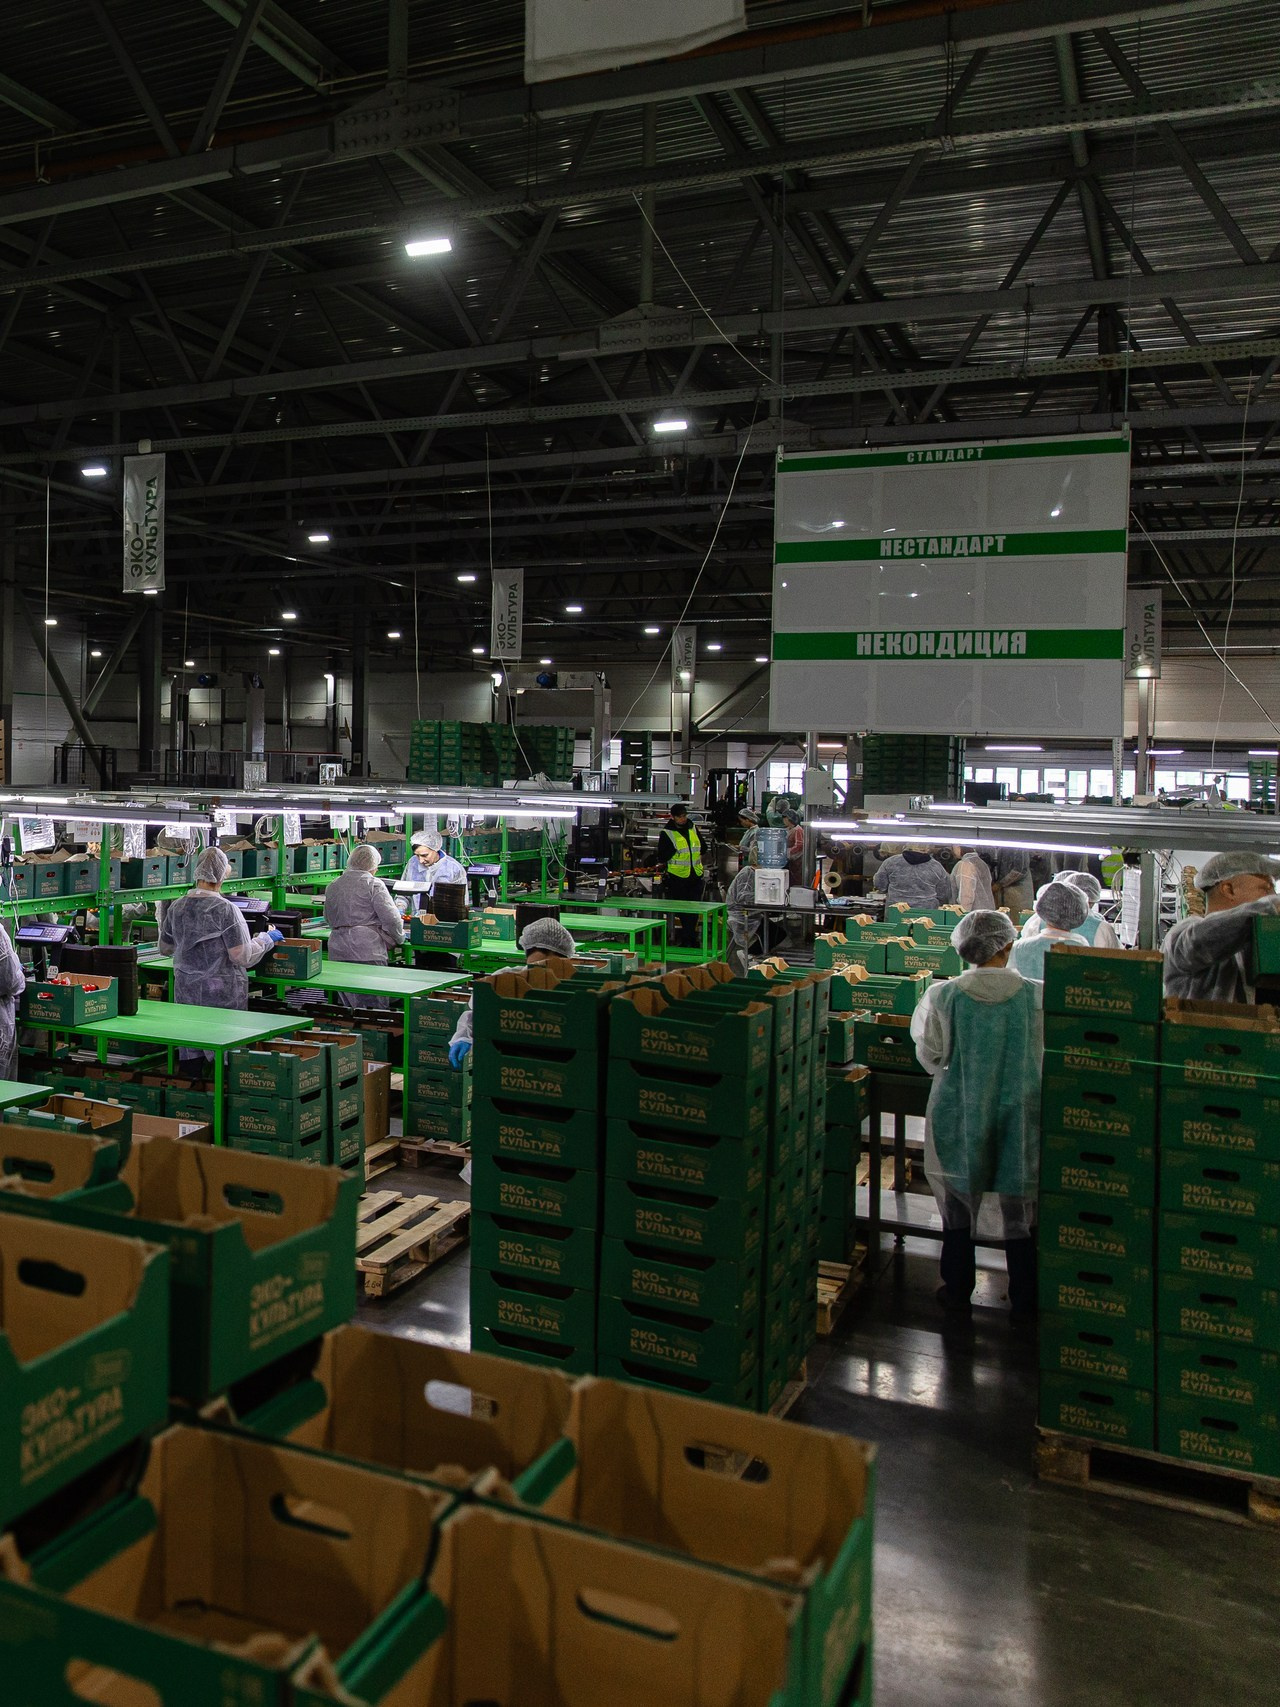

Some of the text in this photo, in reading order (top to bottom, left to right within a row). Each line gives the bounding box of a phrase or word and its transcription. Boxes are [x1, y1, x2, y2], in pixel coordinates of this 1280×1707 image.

[907, 447, 985, 463] СТАНДАРТ
[145, 476, 158, 576] КУЛЬТУРА
[130, 522, 144, 578] ЭКО-
[879, 535, 1007, 557] НЕСТАНДАРТ
[507, 582, 518, 649] КУЛЬТУРА
[496, 613, 506, 650] ЭКО-
[856, 631, 1027, 658] НЕКОНДИЦИЯ
[1065, 986, 1102, 996] ЭКО-
[852, 997, 893, 1006] КУЛЬТУРА
[1065, 995, 1133, 1010] КУЛЬТУРА
[499, 1009, 534, 1020] ЭКО-
[499, 1018, 562, 1035] КУЛЬТУРА
[641, 1028, 678, 1041] ЭКО-
[640, 1038, 709, 1057] КУЛЬТУРА
[239, 1072, 260, 1080] ЭКО-
[500, 1066, 534, 1078] ЭКО-
[239, 1078, 277, 1089] КУЛЬТУРА
[500, 1075, 562, 1094] КУЛЬТУРА
[639, 1089, 676, 1101] ЭКО-
[639, 1099, 706, 1119] КУЛЬТУРА
[1063, 1106, 1100, 1117] ЭКО-
[239, 1115, 260, 1123] ЭКО-
[1063, 1115, 1131, 1133] КУЛЬТУРА
[1183, 1120, 1223, 1131] ЭКО-
[239, 1121, 277, 1133] КУЛЬТУРА
[499, 1125, 533, 1137] ЭКО-
[499, 1135, 561, 1154] КУЛЬТУРА
[1183, 1129, 1255, 1148] КУЛЬТУРА
[636, 1150, 673, 1162] ЭКО-
[636, 1159, 704, 1181] КУЛЬТУРА
[1061, 1166, 1098, 1178] ЭКО-
[499, 1183, 534, 1195] ЭКО-
[1061, 1175, 1129, 1194] КУЛЬТУРА
[1182, 1183, 1222, 1195] ЭКО-
[499, 1192, 562, 1212] КУЛЬТУРА
[1182, 1192, 1255, 1213] КУЛЬТУРА
[635, 1209, 672, 1221] ЭКО-
[635, 1219, 703, 1241] КУЛЬТУРА
[1059, 1224, 1095, 1238] ЭКО-
[498, 1240, 532, 1252] ЭКО-
[1058, 1235, 1126, 1254] КУЛЬТУРА
[498, 1250, 561, 1270] КУЛЬТУРА
[1181, 1247, 1220, 1259] ЭКО-
[1180, 1256, 1254, 1276] КУЛЬТУРА
[631, 1269, 668, 1282] ЭКО-
[631, 1278, 700, 1301] КУЛЬТУРА
[1058, 1284, 1095, 1297] ЭКО-
[498, 1300, 532, 1313] ЭКО-
[1058, 1294, 1126, 1315] КУЛЬТУРА
[498, 1309, 560, 1331] КУЛЬТУРА
[1180, 1307, 1219, 1321] ЭКО-
[630, 1328, 667, 1342] ЭКО-
[1180, 1318, 1253, 1338] КУЛЬТУРА
[629, 1338, 698, 1363] КУЛЬТУРА
[1060, 1346, 1097, 1359] ЭКО-
[1060, 1355, 1128, 1376] КУЛЬТУРА
[1180, 1369, 1220, 1383] ЭКО-
[1180, 1380, 1253, 1401] КУЛЬТУРА
